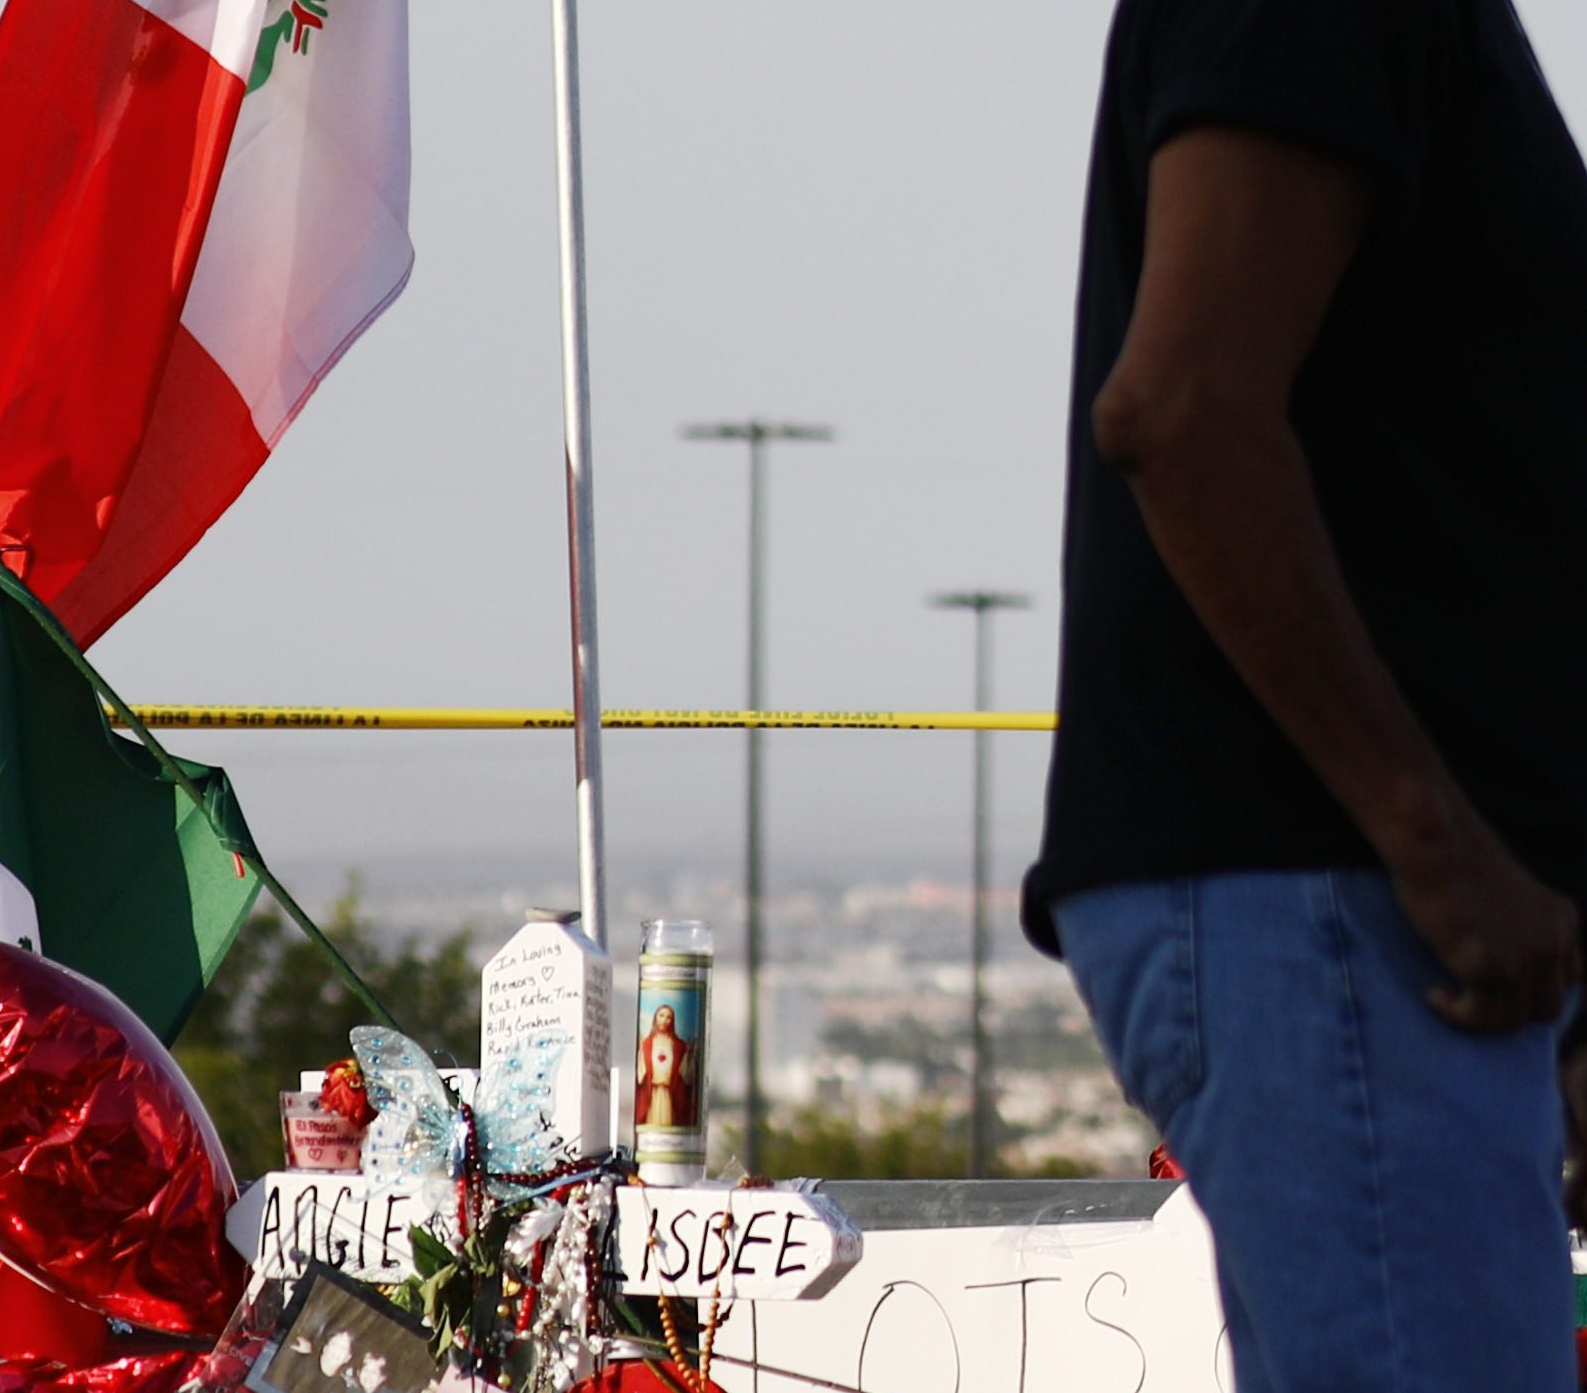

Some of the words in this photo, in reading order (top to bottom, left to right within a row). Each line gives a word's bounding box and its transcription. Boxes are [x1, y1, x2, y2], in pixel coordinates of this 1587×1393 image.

[522, 944, 562, 962] Loving
[489, 976, 536, 995] Memory
[487, 1019, 512, 1037] Billy
[258, 1184, 412, 1275] ANGIE
